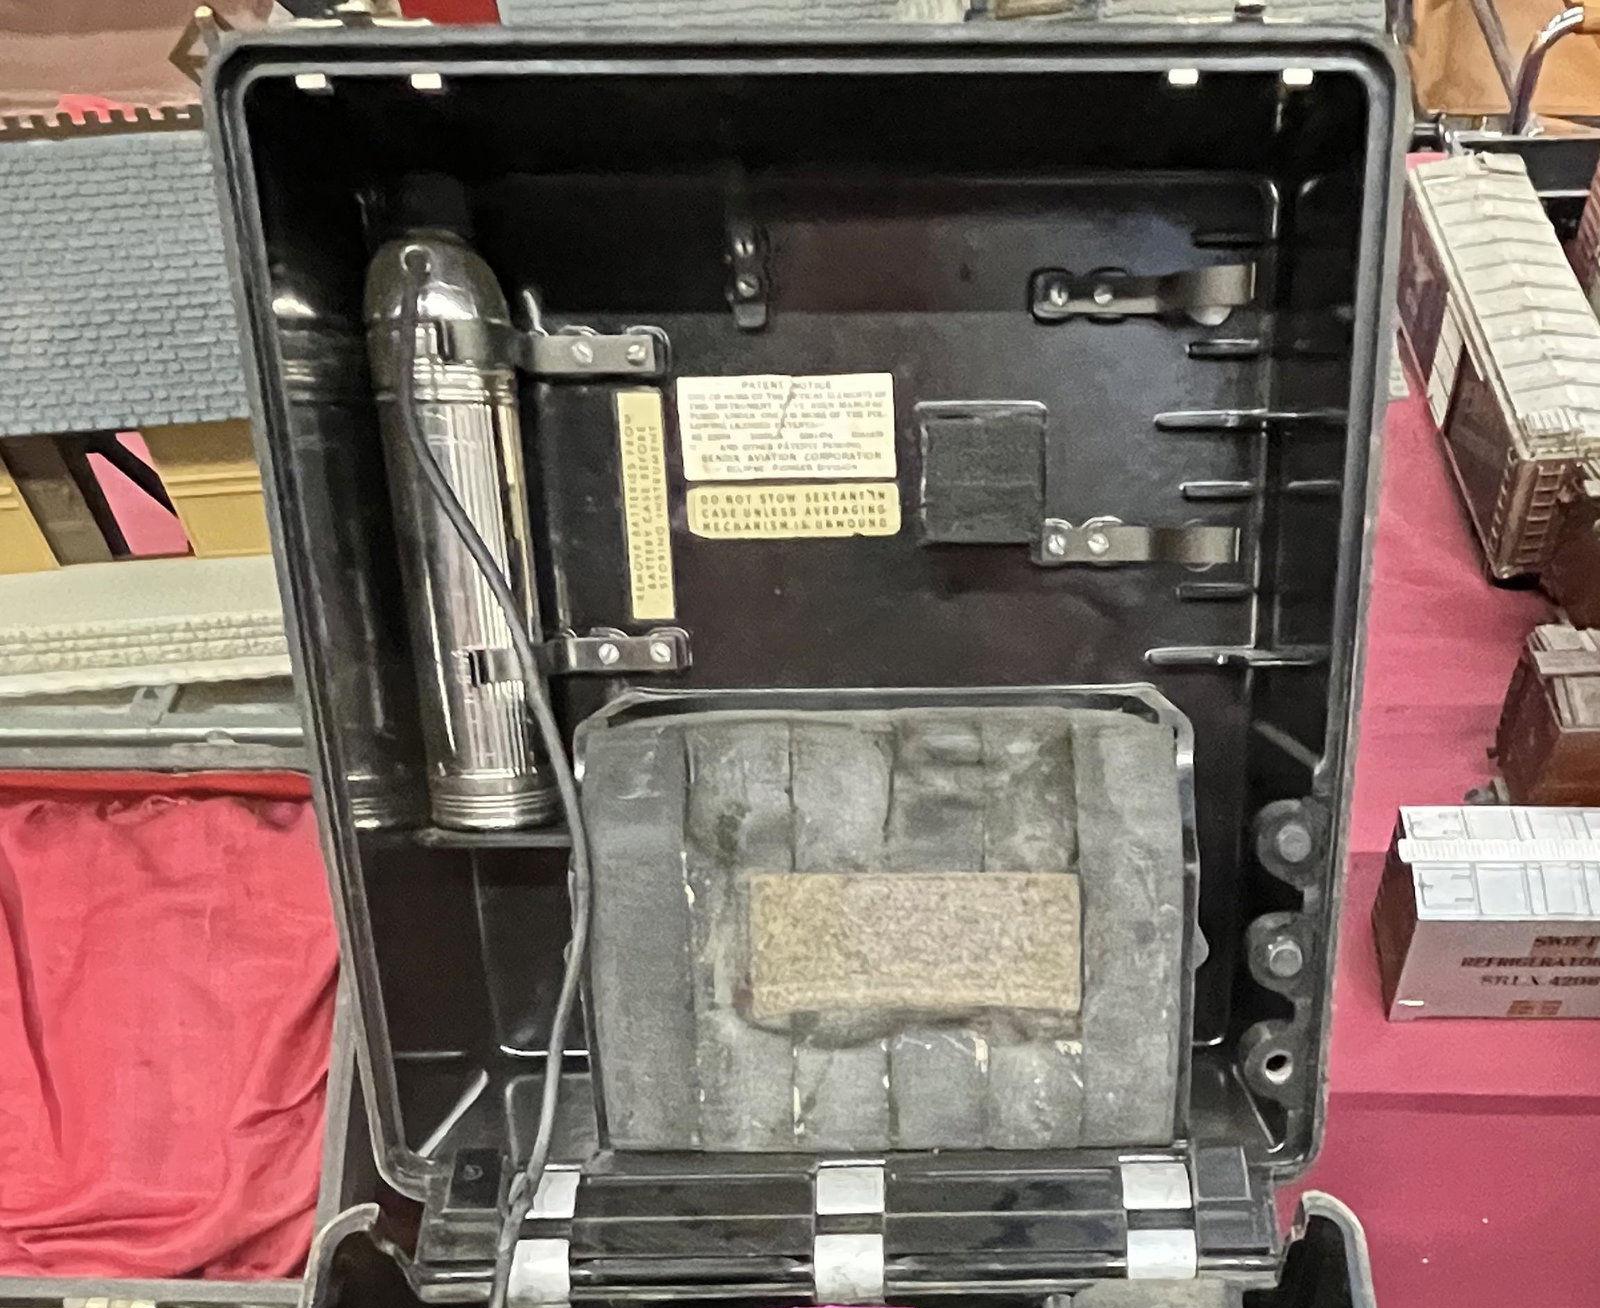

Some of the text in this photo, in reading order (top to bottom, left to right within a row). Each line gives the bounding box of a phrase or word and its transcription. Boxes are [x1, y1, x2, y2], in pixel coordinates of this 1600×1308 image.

[742, 381, 783, 390] PATENT
[702, 452, 882, 463] BENDIX AVIATION CORPORATION
[627, 463, 641, 537] BATTERIES
[701, 494, 719, 505] DO
[726, 494, 751, 505] NOT
[760, 493, 795, 504] STOW
[805, 490, 864, 503] SEXTANT
[636, 426, 657, 590] BATTERY CASE BEFORE
[648, 426, 669, 590] STORING INSTRUMENT
[702, 504, 886, 519] CASE UNLESS AVERAGING
[703, 520, 788, 532] MECHANISM
[815, 518, 887, 530] UNWOUND
[633, 545, 645, 601] REMOVE
[1534, 936, 1600, 948] SWIFT
